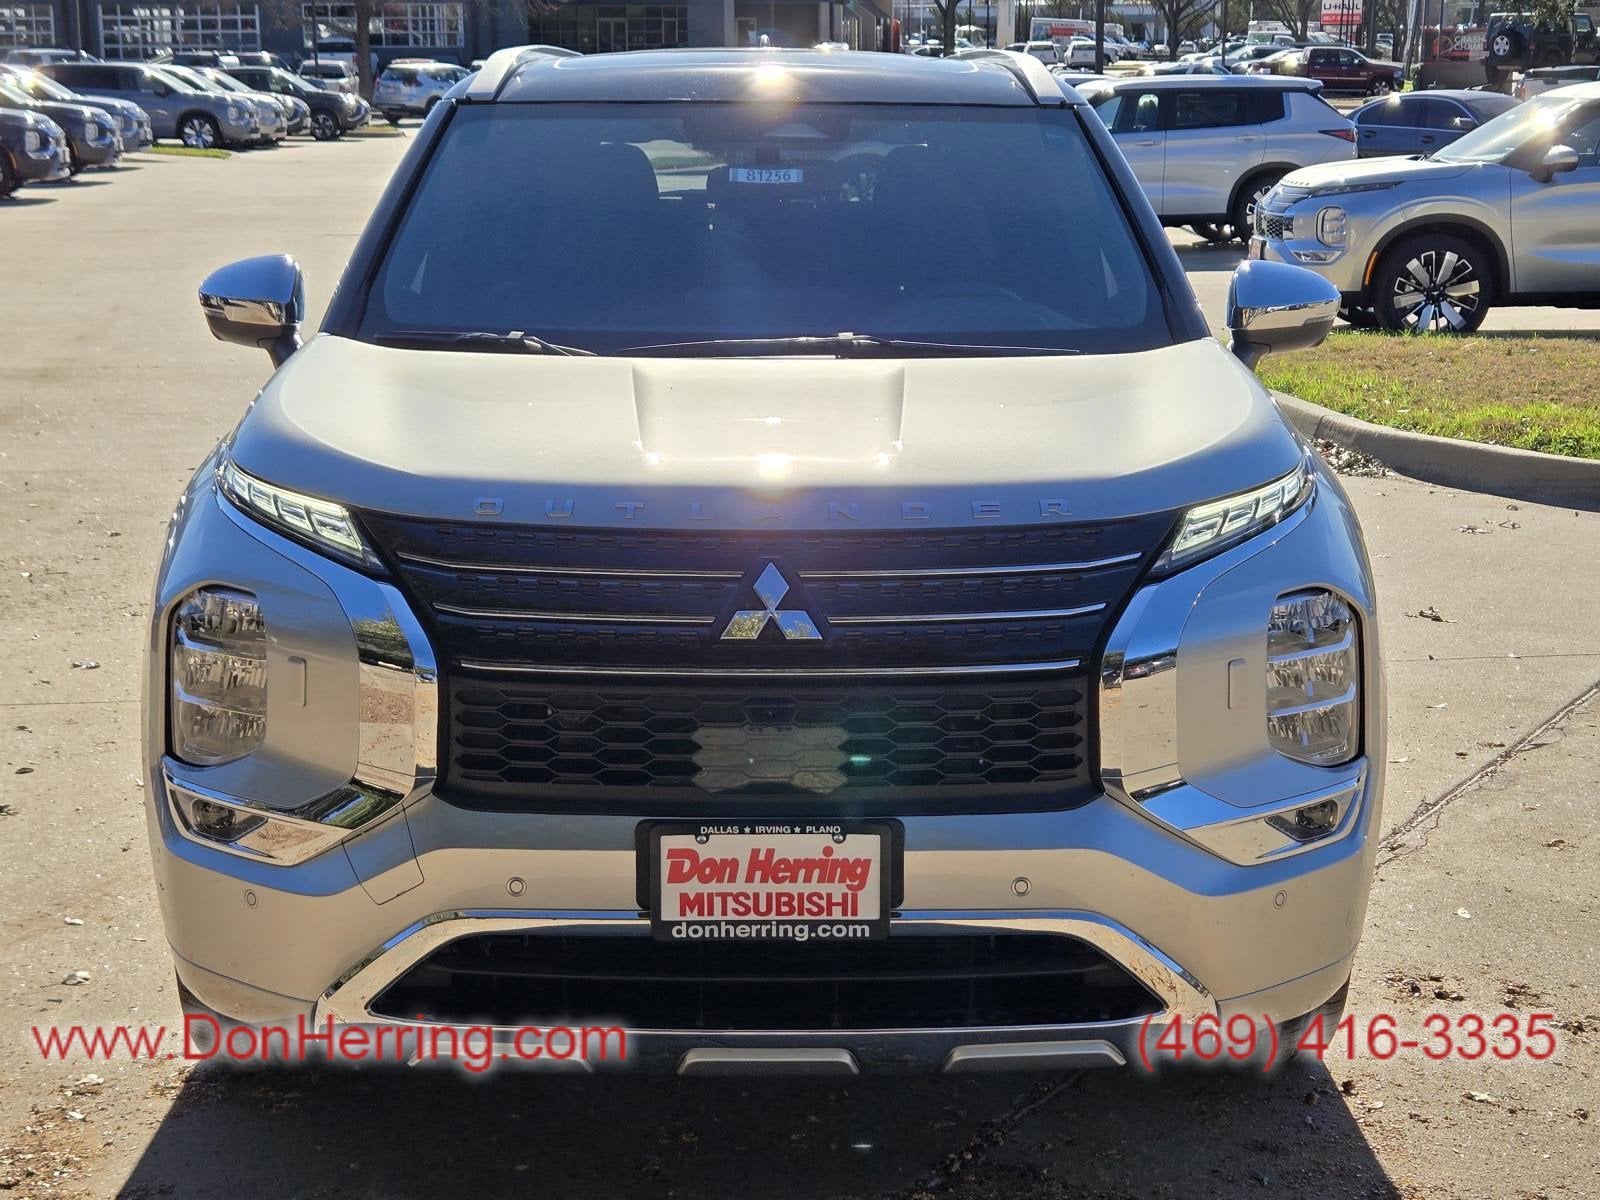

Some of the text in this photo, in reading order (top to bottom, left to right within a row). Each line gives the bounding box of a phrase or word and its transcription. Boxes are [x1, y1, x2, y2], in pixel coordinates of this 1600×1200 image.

[746, 169, 791, 182] 81256
[472, 496, 1073, 521] OUTLANDER
[700, 825, 841, 834] DALLAS IRVING PLANO
[666, 845, 872, 892] Don Herring
[679, 891, 859, 917] MITSUBISHI
[671, 921, 870, 941] donherring.com
